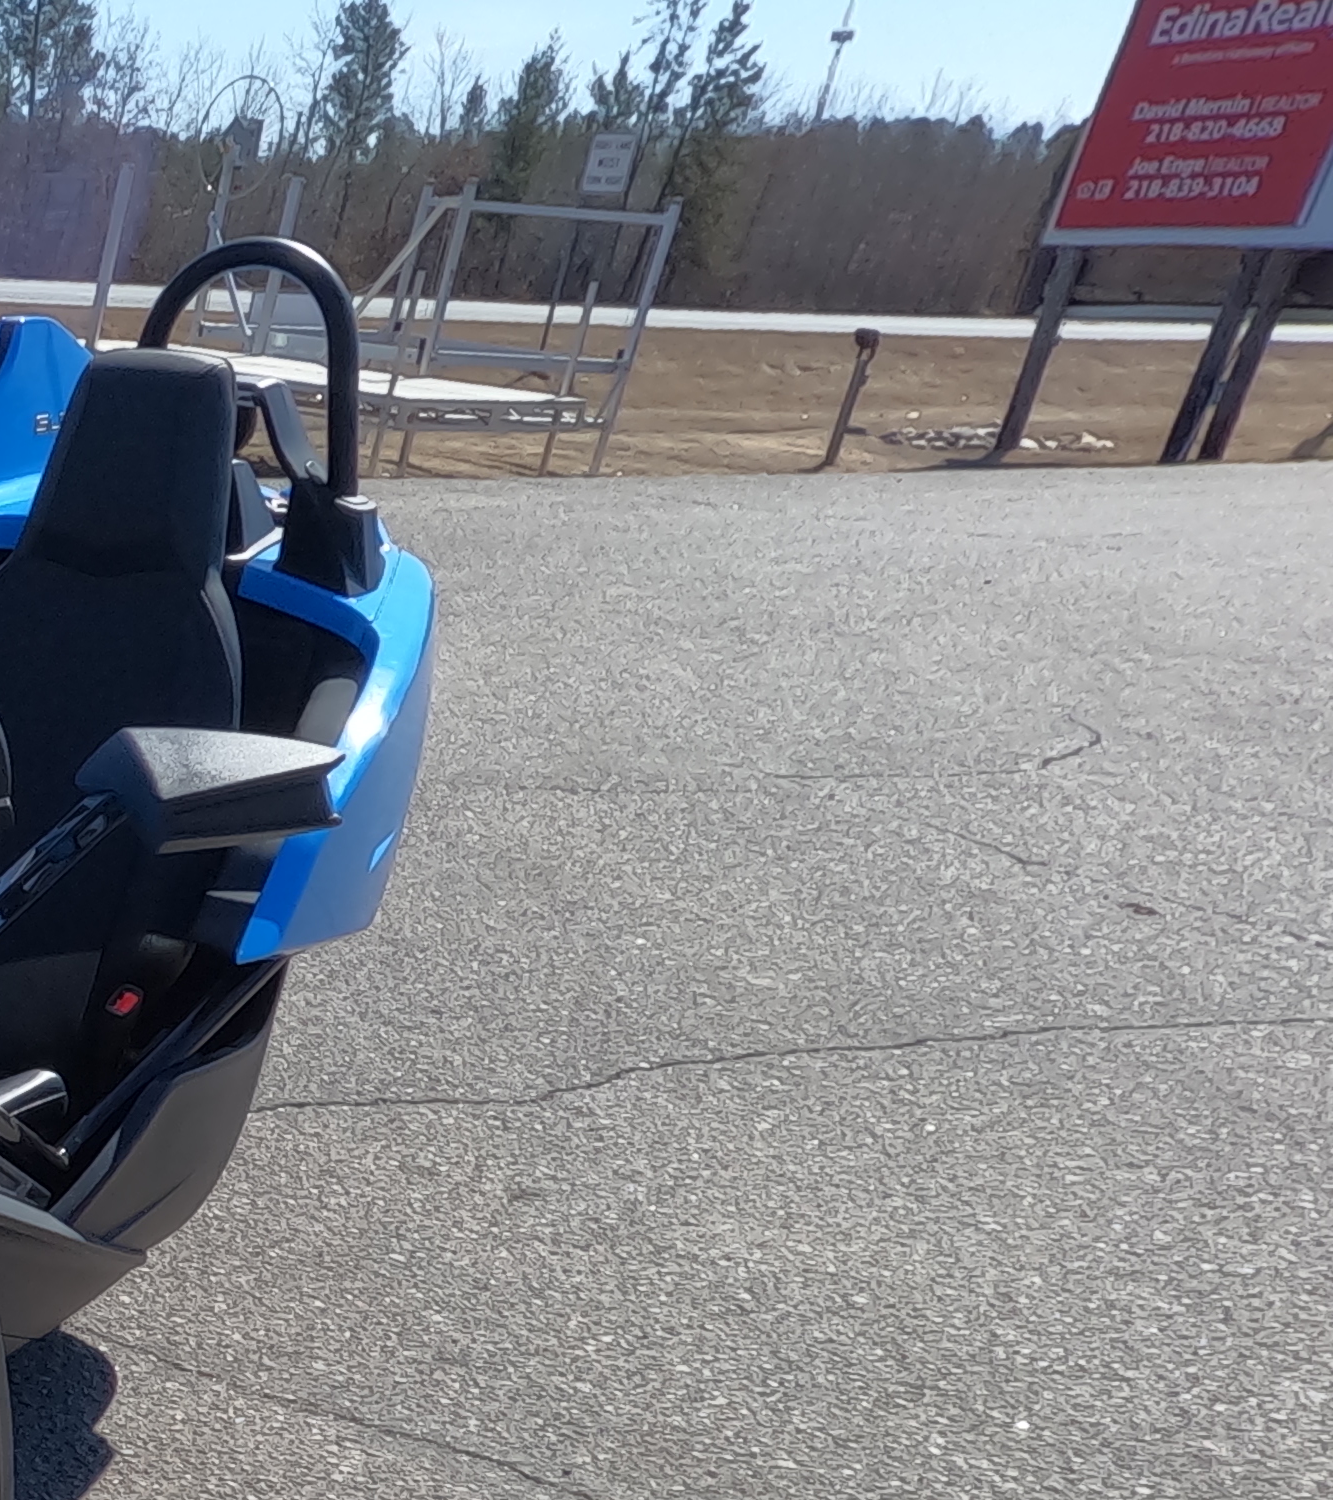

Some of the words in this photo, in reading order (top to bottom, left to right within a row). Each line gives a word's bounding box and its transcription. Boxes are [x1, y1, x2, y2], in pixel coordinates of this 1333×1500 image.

[1149, 3, 1248, 45] Edina
[1241, 0, 1333, 40] Real
[1132, 98, 1187, 121] David
[1144, 116, 1286, 144] 218-820-4668
[1127, 156, 1161, 177] Joe
[1121, 175, 1261, 200] 218-839-3104
